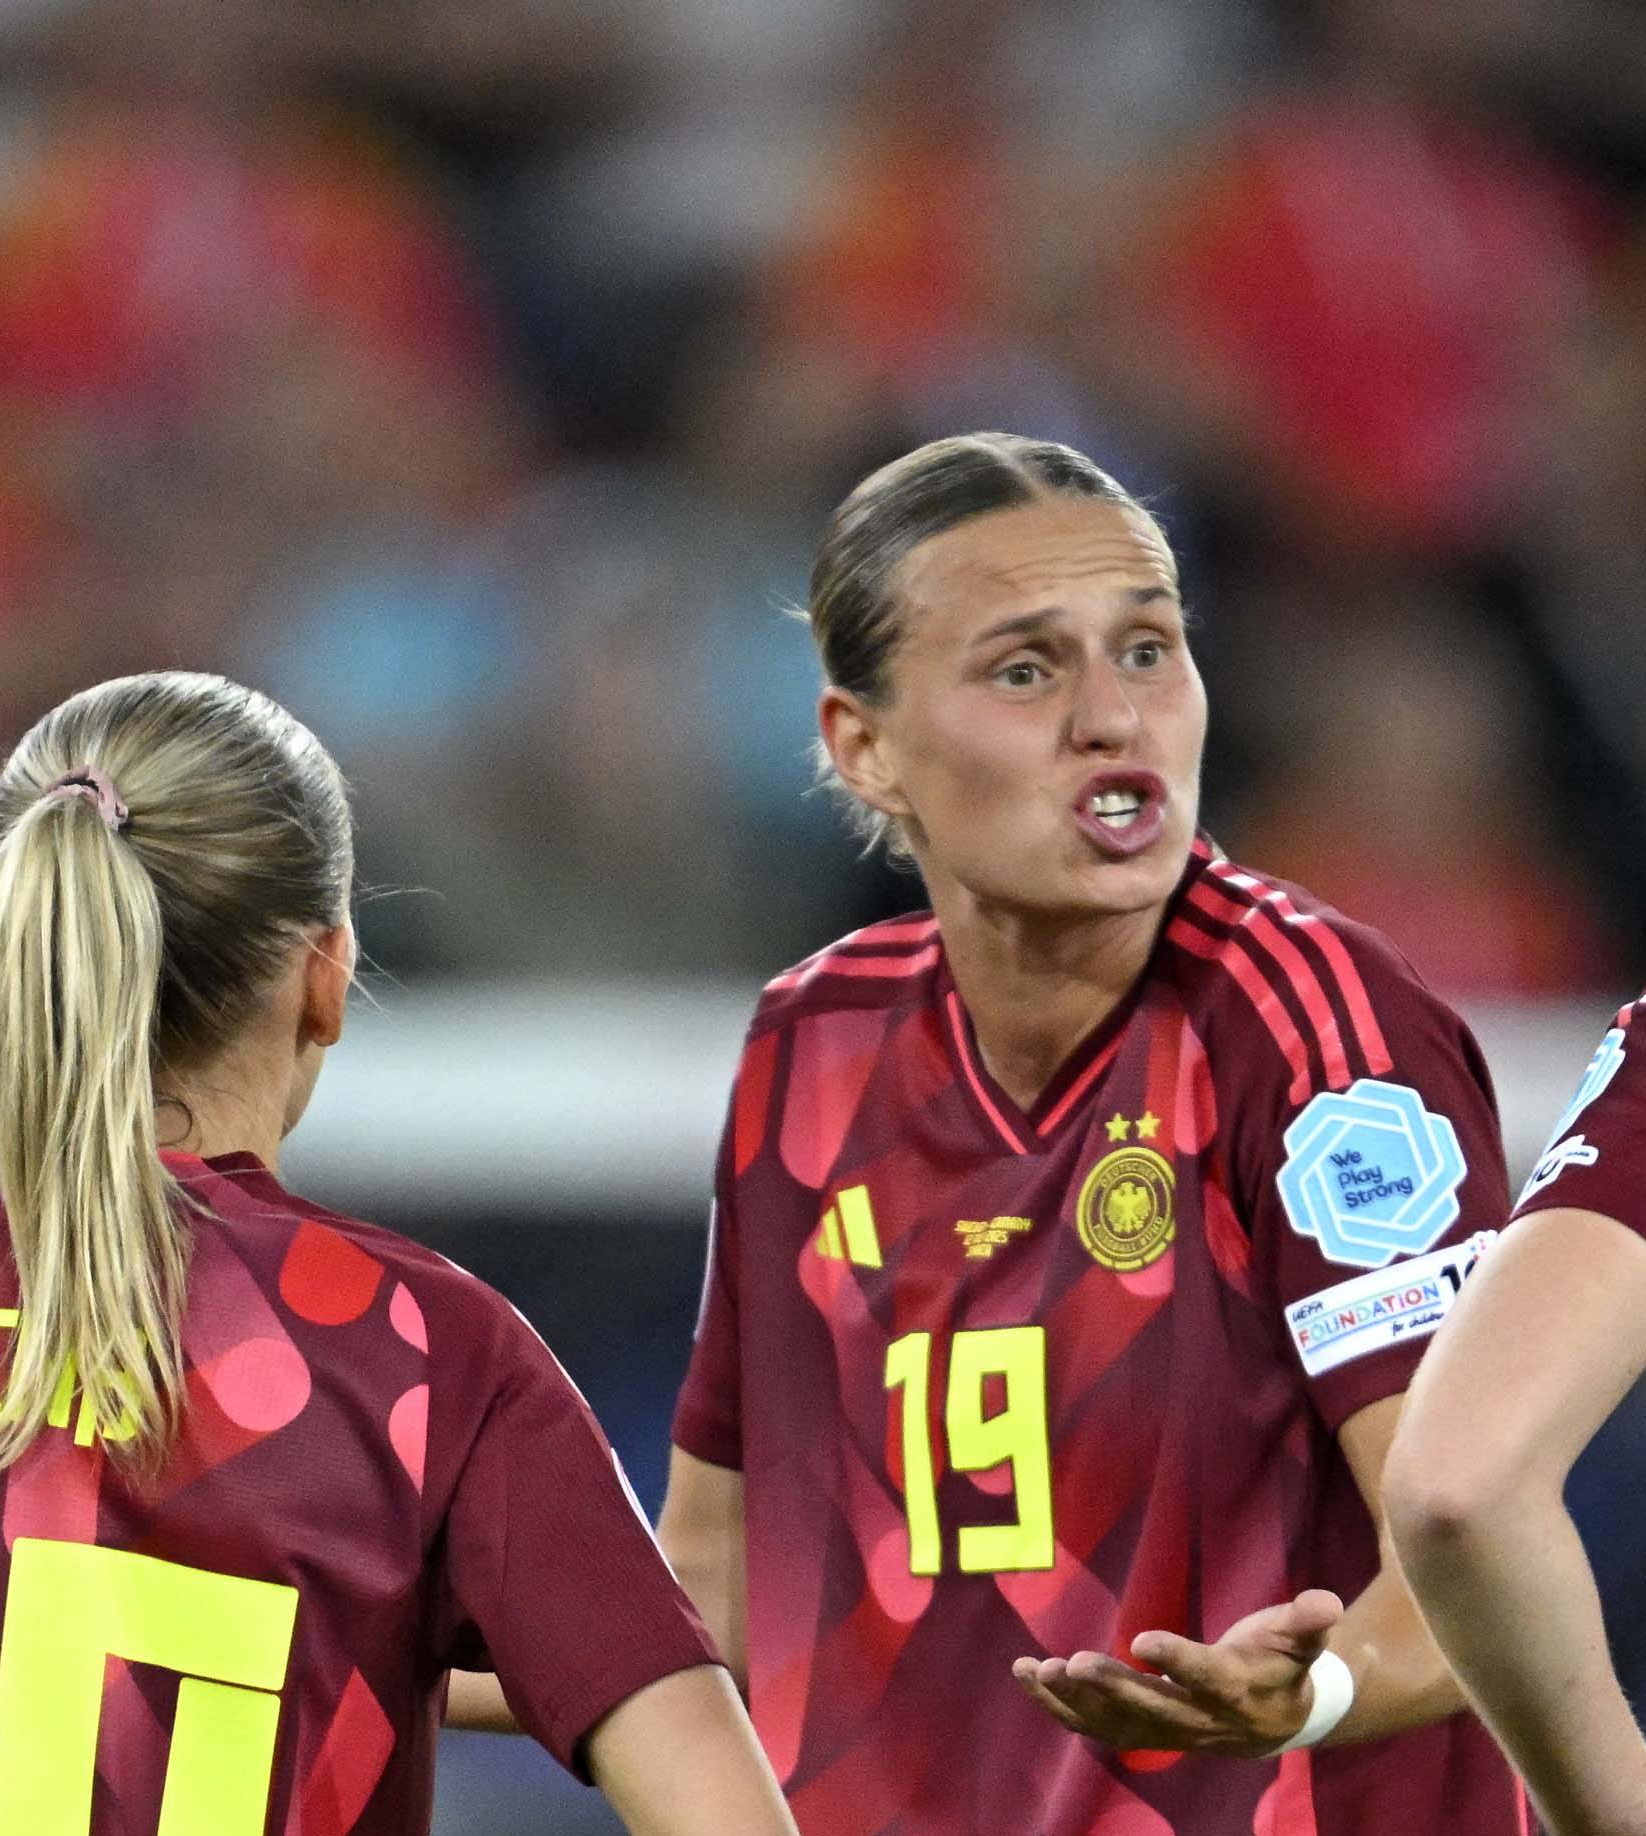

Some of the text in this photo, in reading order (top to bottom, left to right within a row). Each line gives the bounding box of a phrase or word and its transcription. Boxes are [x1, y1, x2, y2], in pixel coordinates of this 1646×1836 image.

[1329, 1149, 1362, 1168] We
[1337, 1165, 1383, 1189] Play
[1344, 1175, 1413, 1208] Strong
[1298, 1282, 1440, 1348] FOUNDATION
[884, 1325, 1055, 1577] 19
